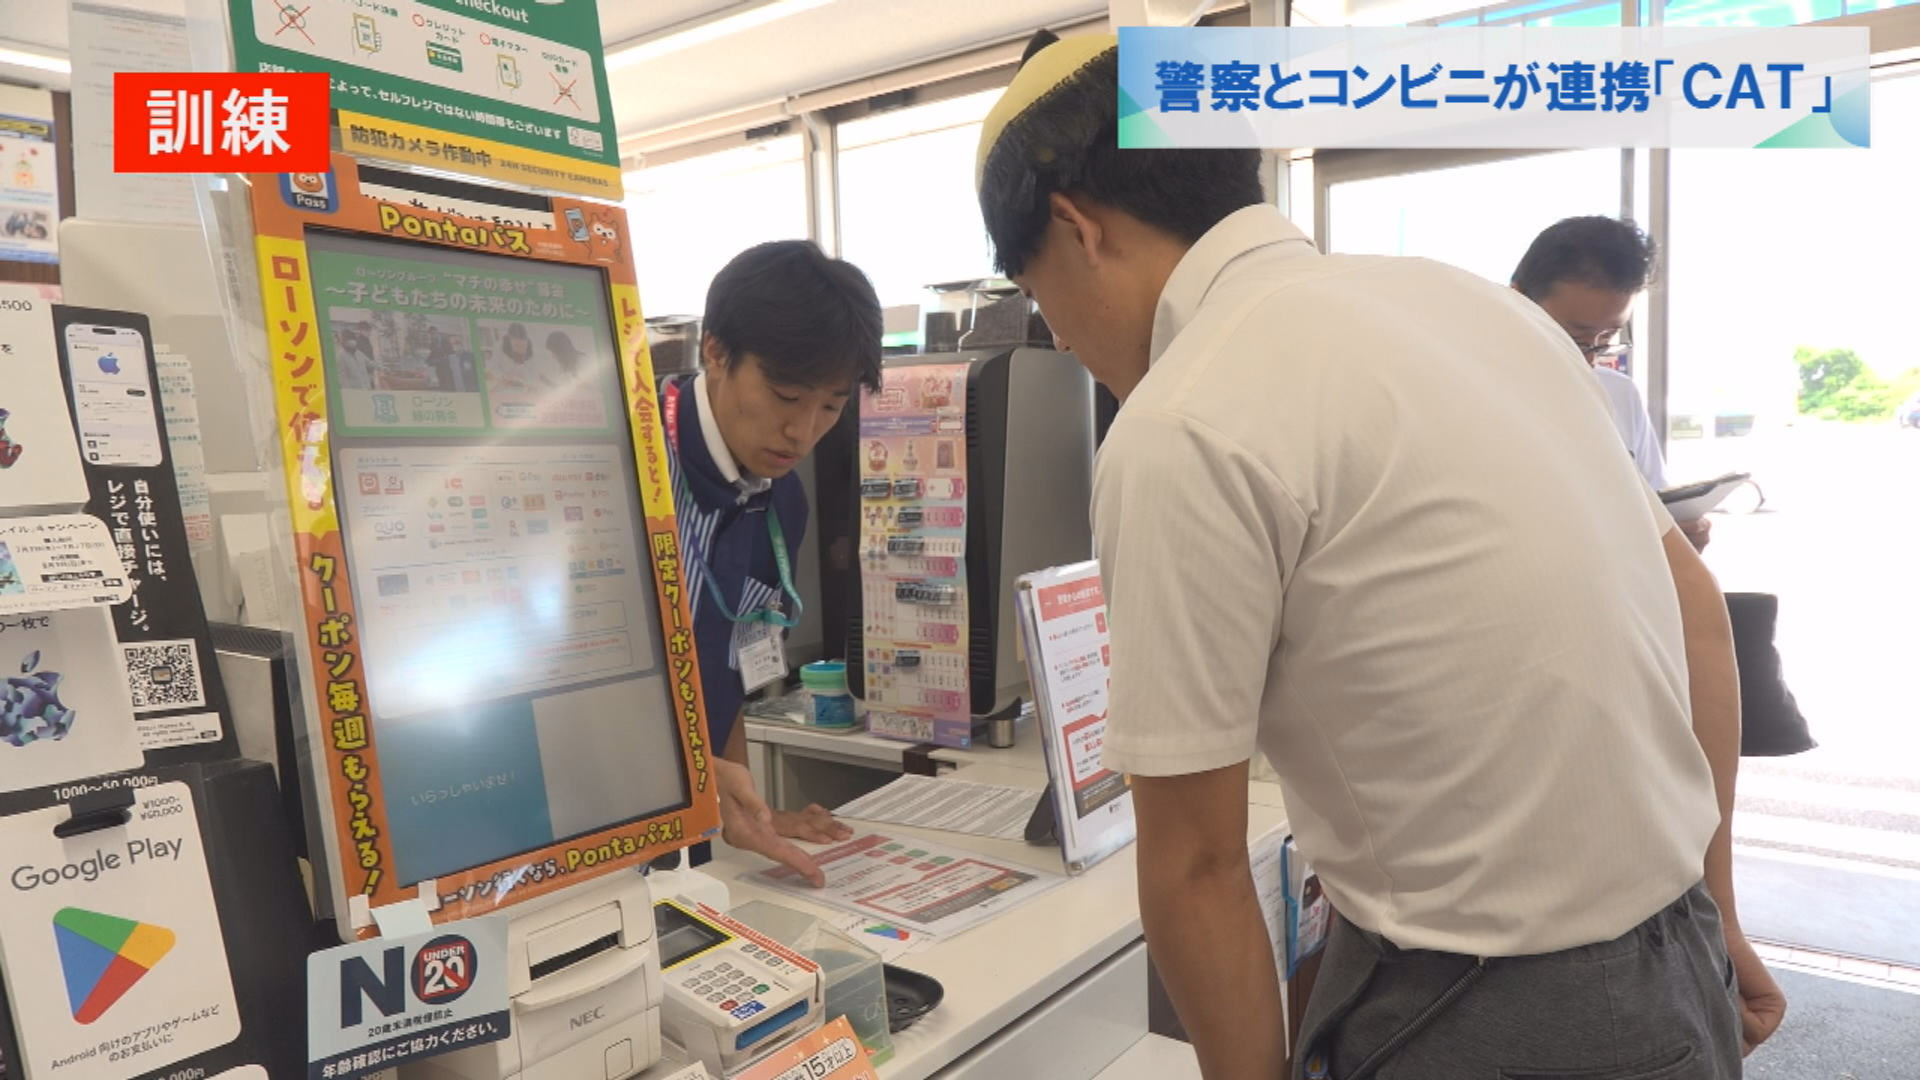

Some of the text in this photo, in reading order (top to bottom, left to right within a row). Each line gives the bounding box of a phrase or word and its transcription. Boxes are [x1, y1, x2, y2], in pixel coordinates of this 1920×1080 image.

[350, 124, 492, 168] 防犯カメラ作動中
[522, 163, 566, 179] SECURITY
[567, 172, 609, 187] CAMERAS
[297, 194, 326, 209] Pass
[379, 204, 531, 253] Pontaパス
[107, 480, 149, 631] レジで直接チャージ。
[134, 479, 167, 581] 自分使いには、
[652, 532, 707, 792] 限定クーポンもらえる!
[311, 552, 384, 896] クーポン毎週もらえる!
[411, 771, 516, 806] いらっしゃいませ!
[11, 837, 183, 891] Google Play
[423, 945, 465, 962] UNDER
[424, 955, 467, 995] 20
[51, 1004, 220, 1070] Android 向けのアプリやゲームなど
[570, 1006, 606, 1030] NEC
[321, 1022, 499, 1079] 年齢確認にご協力ください。
